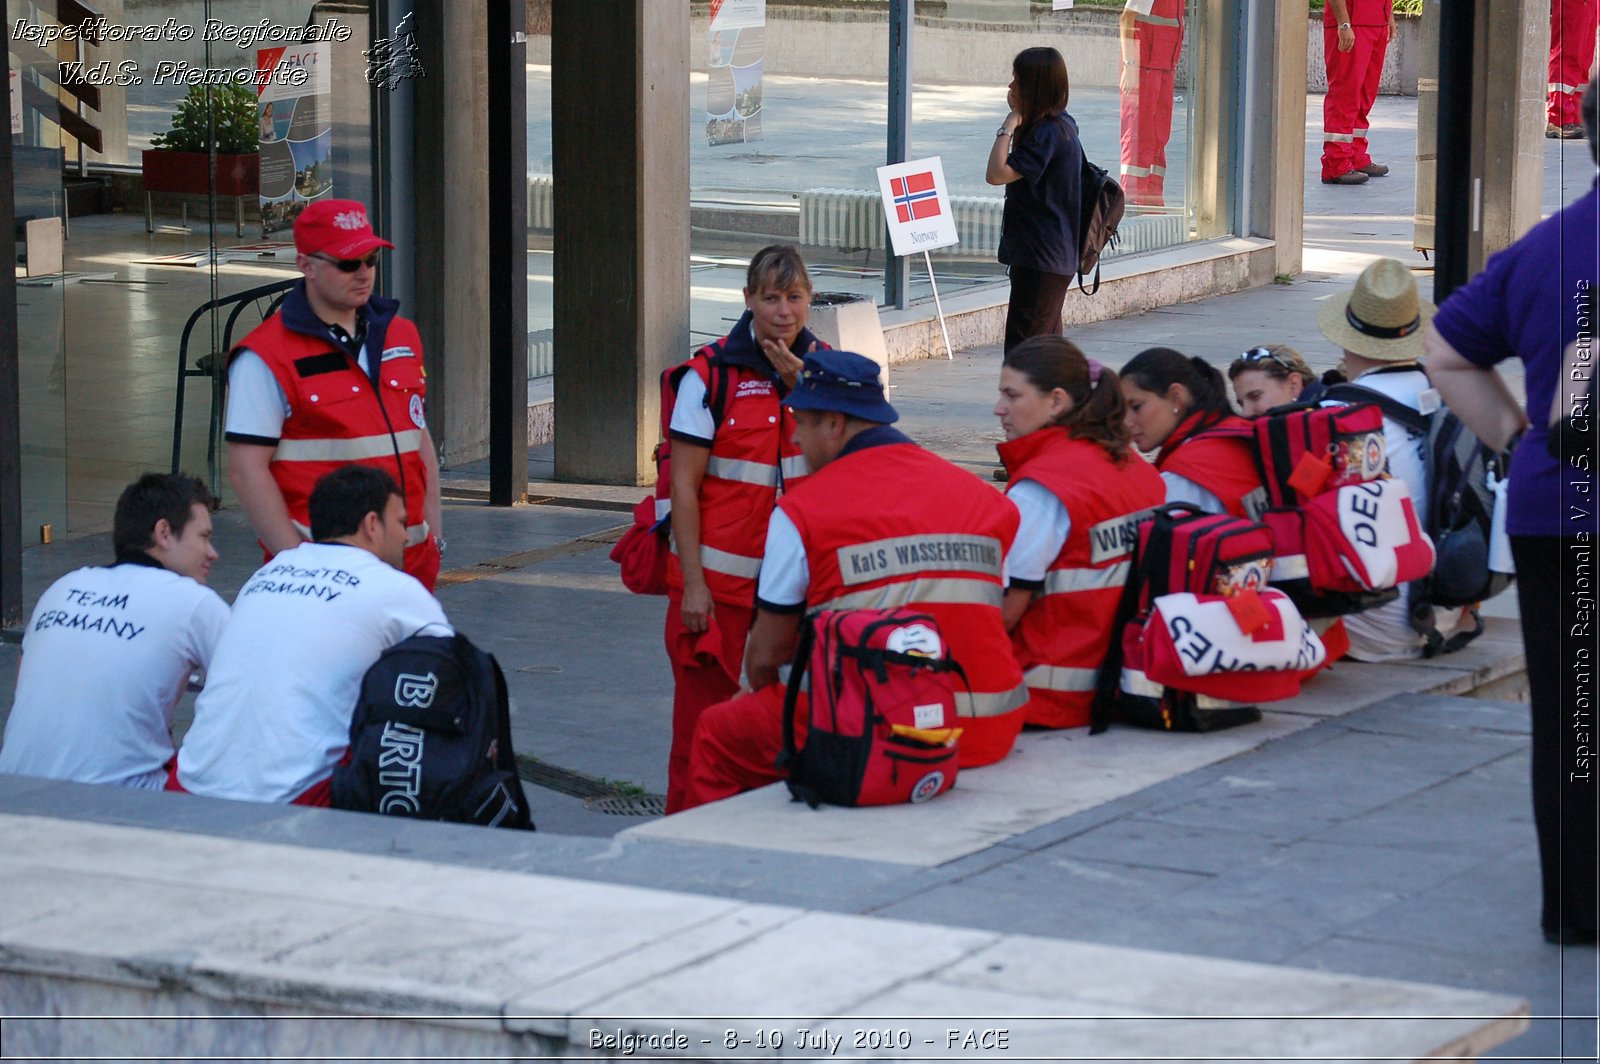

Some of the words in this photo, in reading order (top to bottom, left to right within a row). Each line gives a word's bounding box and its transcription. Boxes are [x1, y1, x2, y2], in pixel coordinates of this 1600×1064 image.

[910, 230, 939, 245] Norway
[895, 541, 998, 567] WASSERRETTUNG
[66, 588, 129, 610] TEAM
[35, 609, 145, 640] GERMANY
